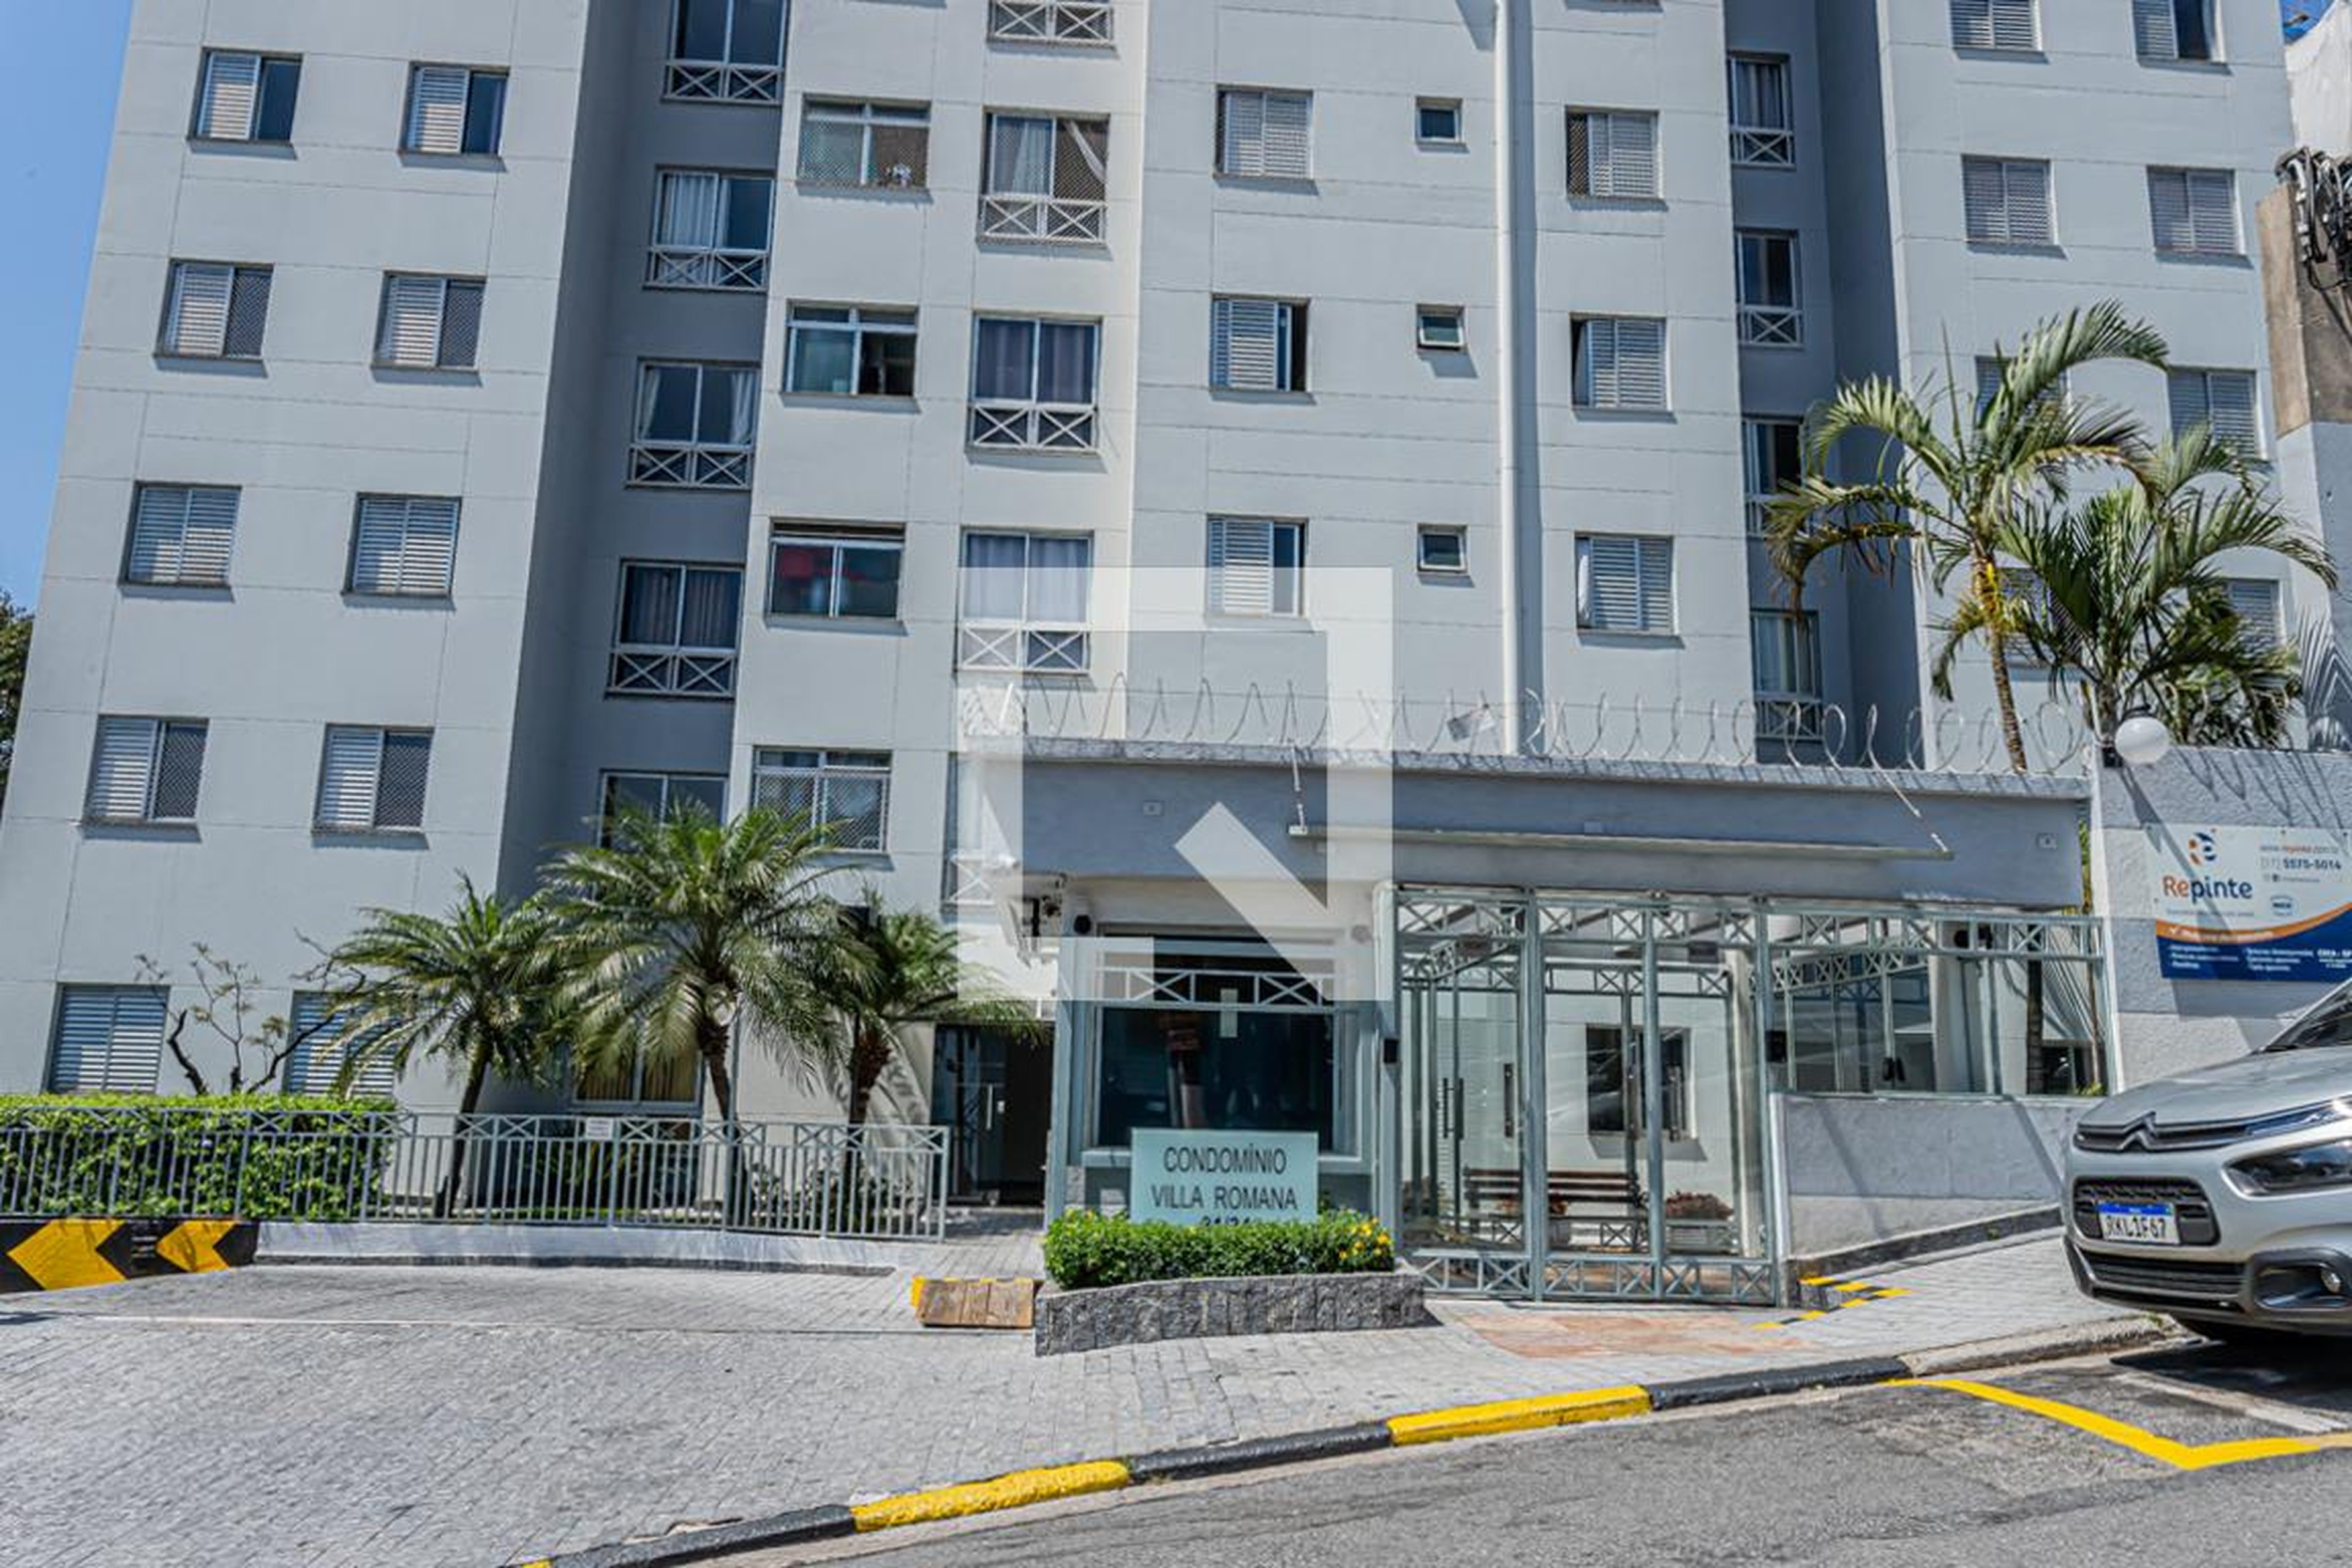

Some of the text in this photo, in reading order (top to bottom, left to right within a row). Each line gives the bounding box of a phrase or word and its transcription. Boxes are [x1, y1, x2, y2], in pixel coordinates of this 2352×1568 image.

[2163, 875, 2253, 905] Repinte
[1164, 1143, 1286, 1174] CONDOMÍNIO
[1151, 1183, 1298, 1210] VILLA ROMANA
